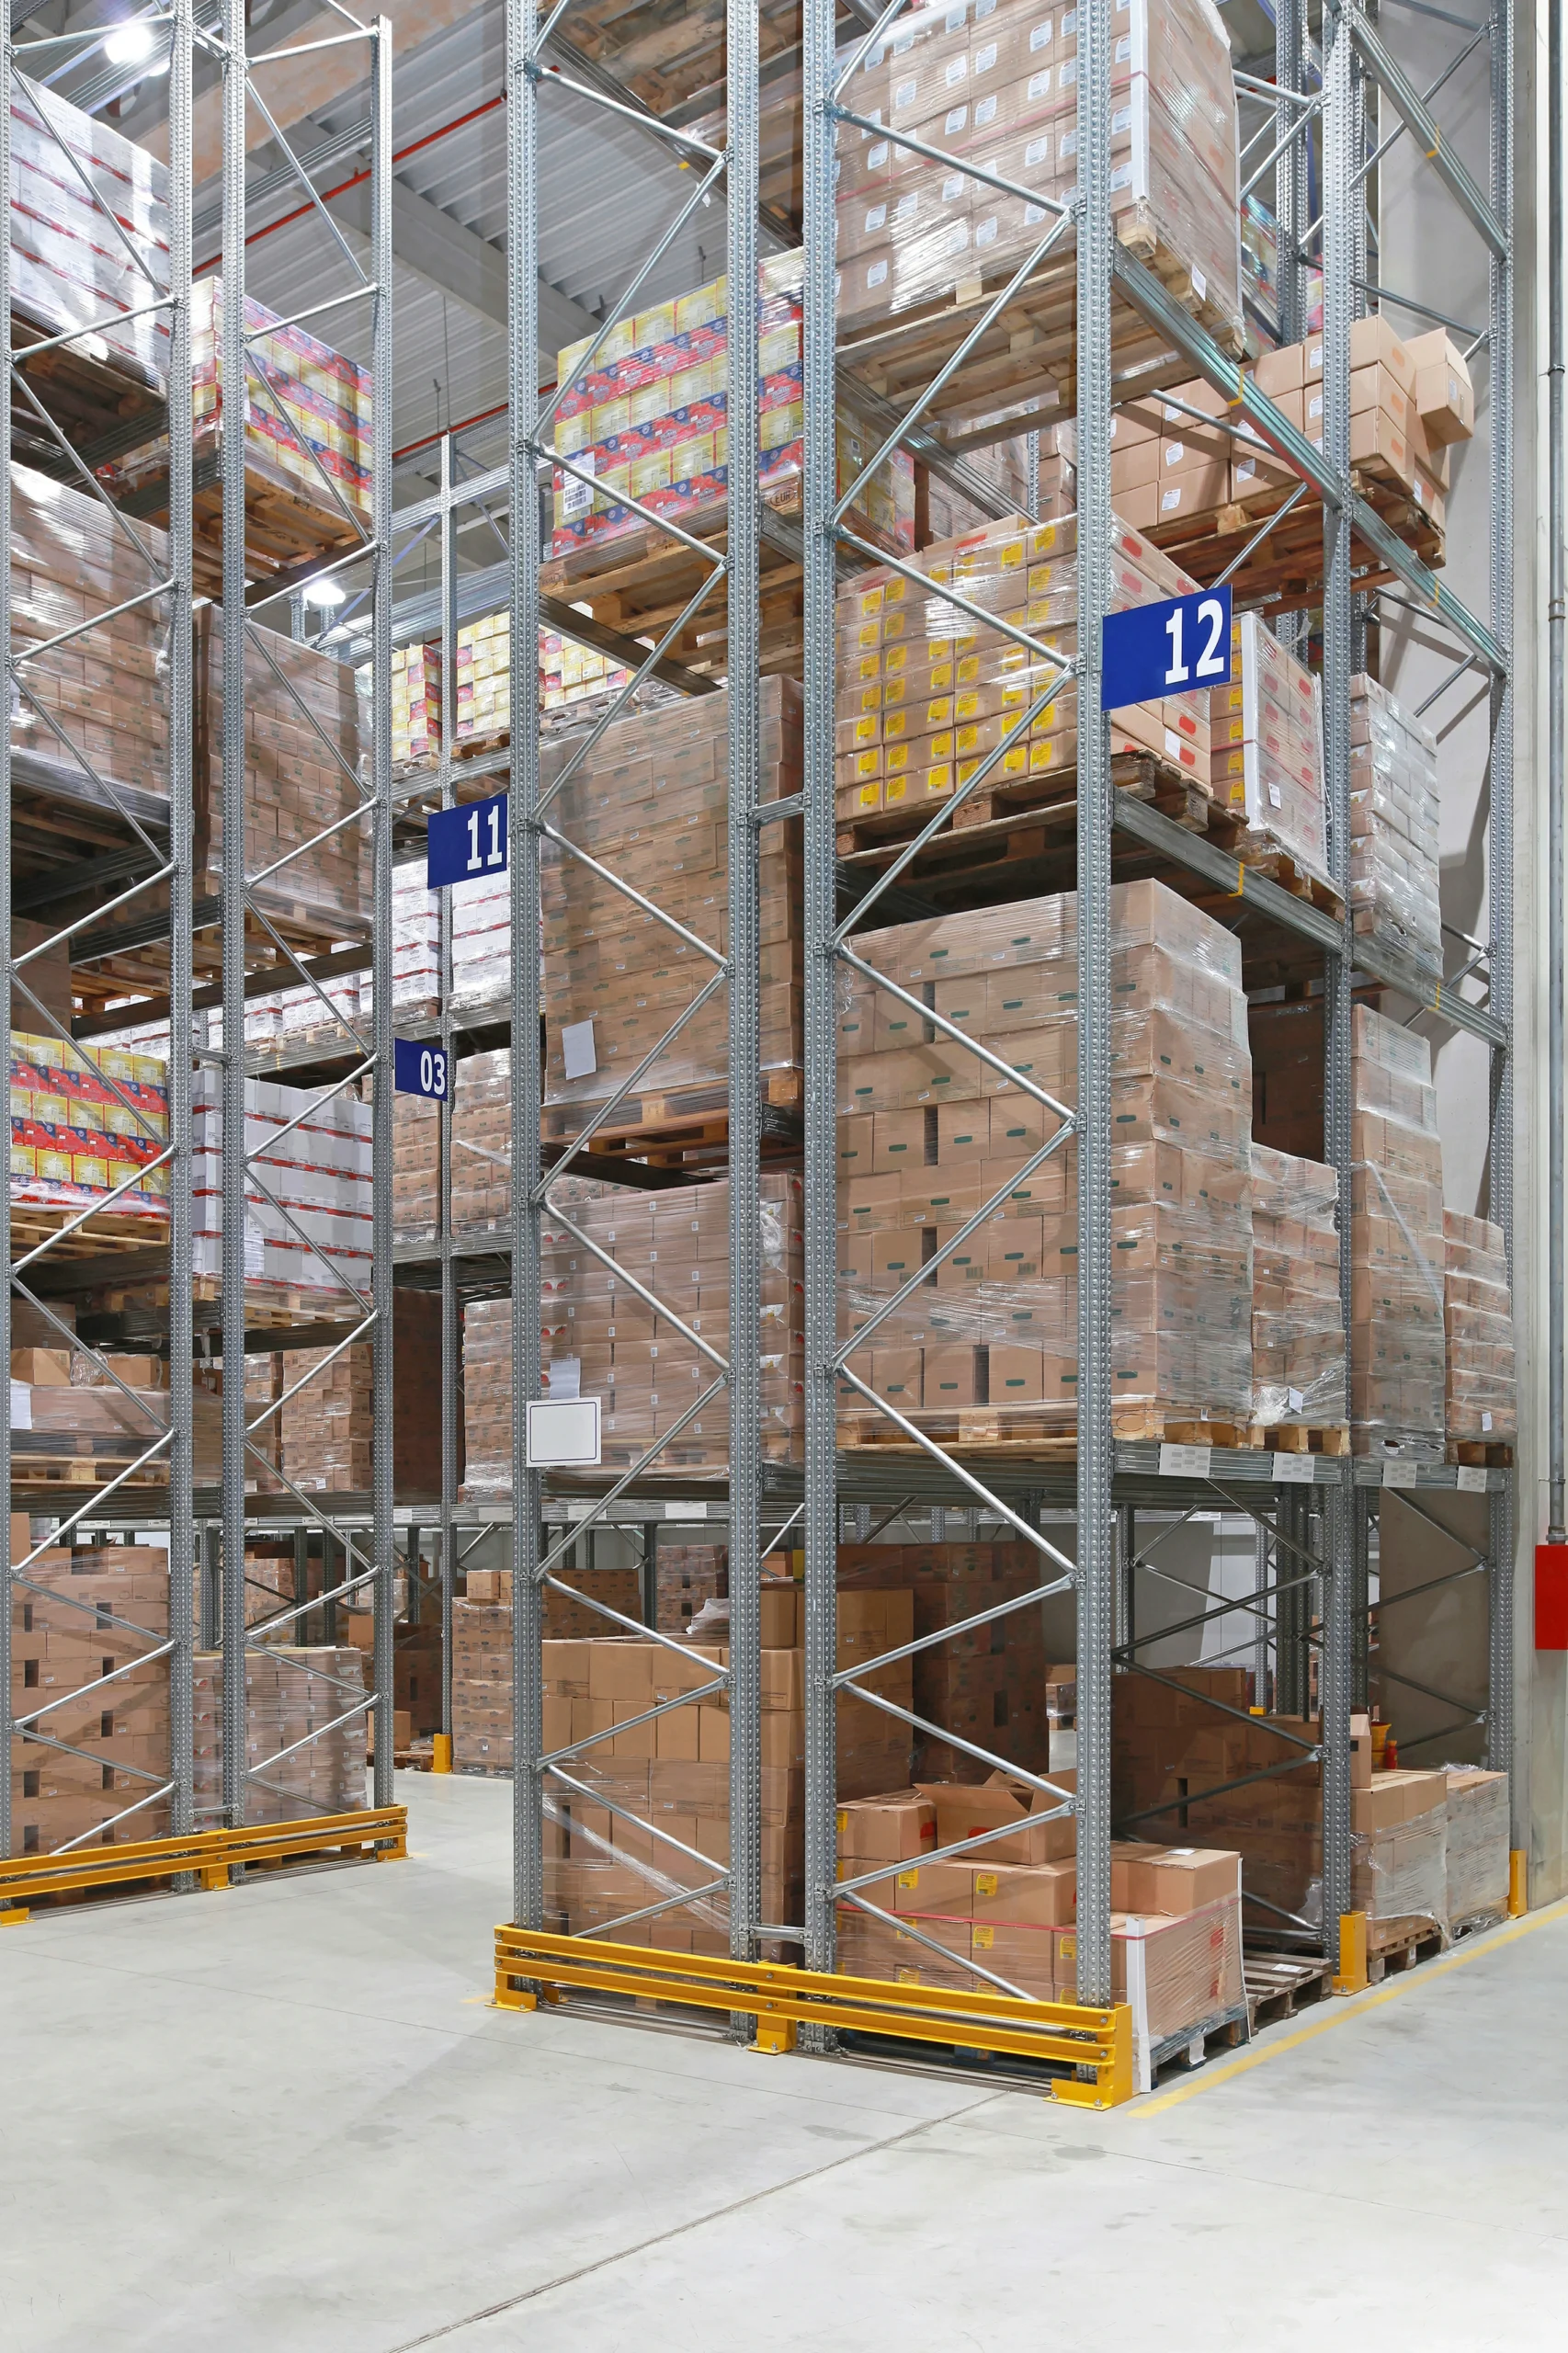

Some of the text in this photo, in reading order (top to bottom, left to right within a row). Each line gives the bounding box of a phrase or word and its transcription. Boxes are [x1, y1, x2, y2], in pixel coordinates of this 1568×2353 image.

[1165, 598, 1224, 685] 12
[467, 804, 503, 871] 11
[420, 1050, 446, 1096] 03
